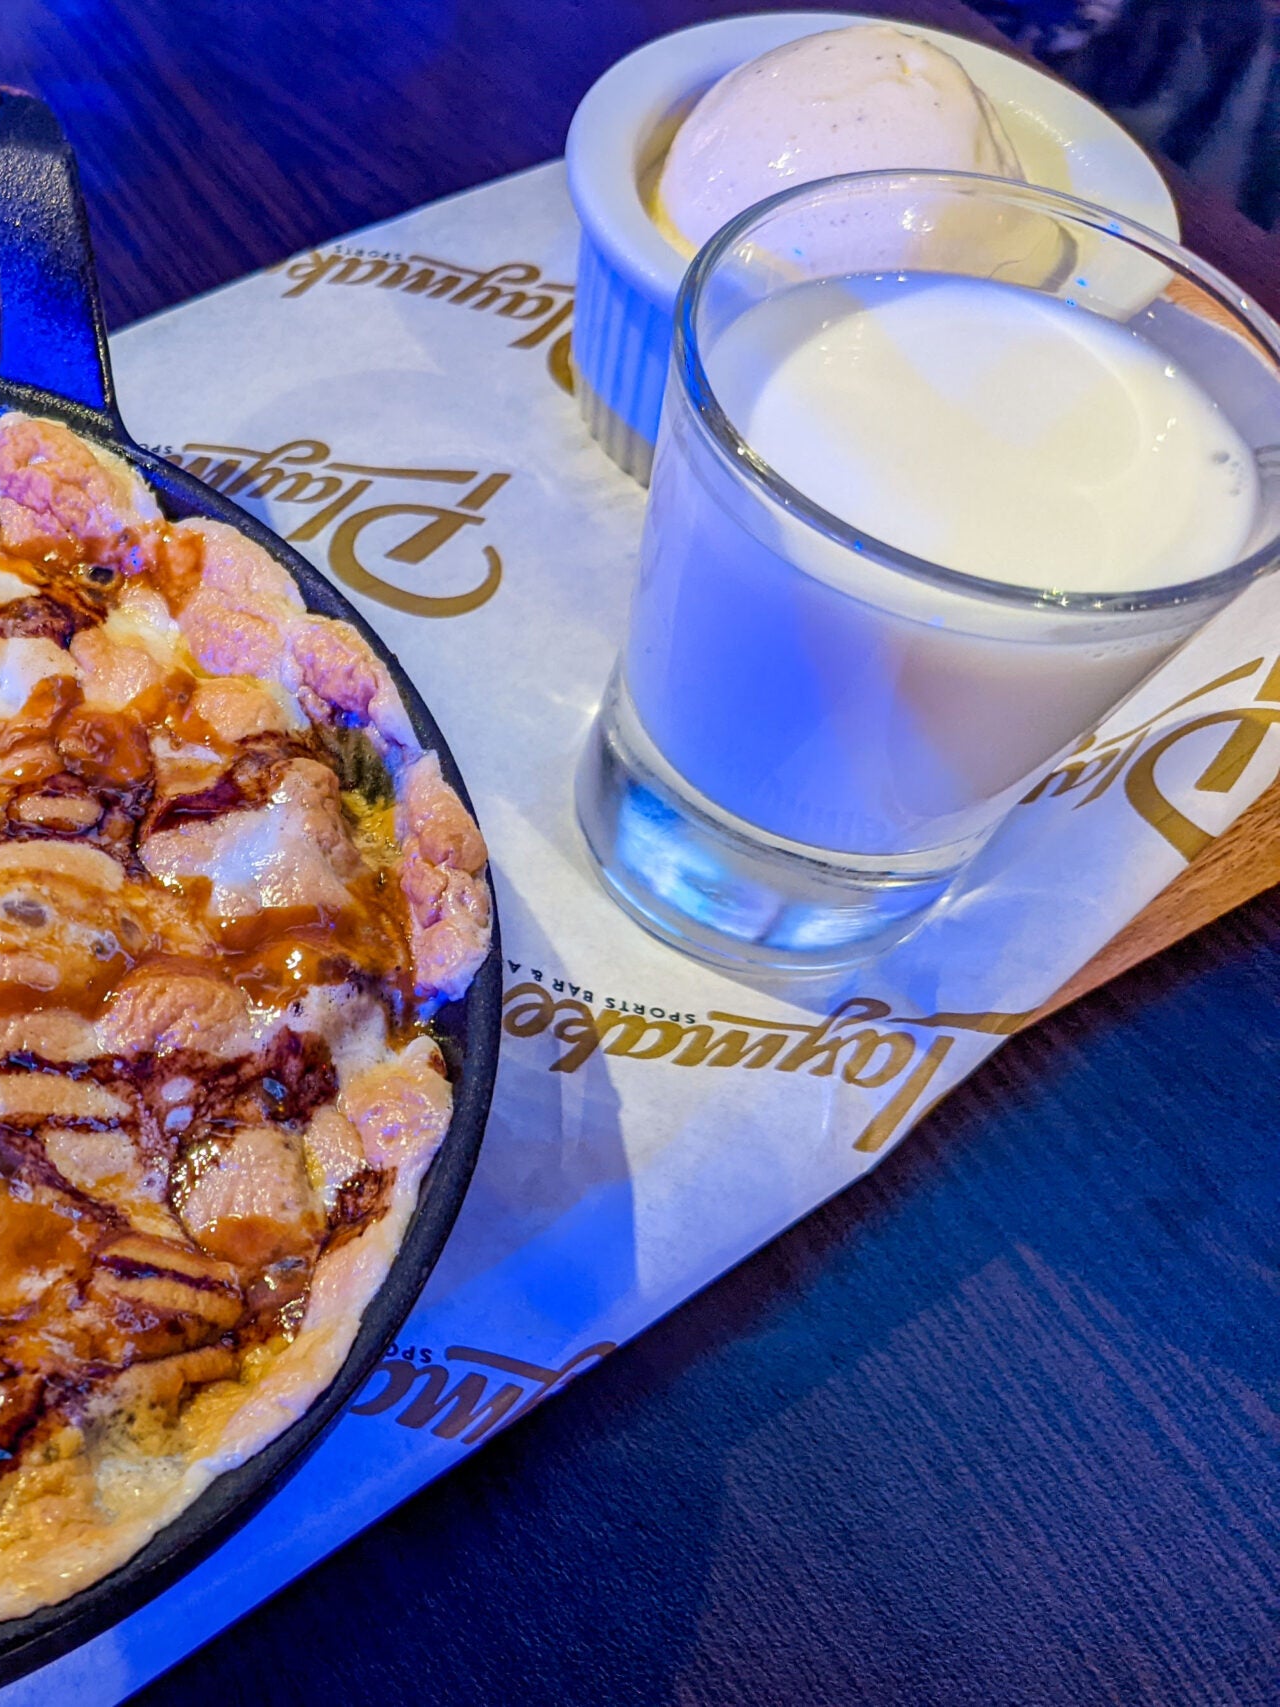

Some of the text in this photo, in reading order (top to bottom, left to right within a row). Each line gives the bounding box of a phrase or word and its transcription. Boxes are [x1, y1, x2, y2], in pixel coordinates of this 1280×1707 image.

[530, 968, 544, 984] &
[552, 978, 594, 1004] BAR
[605, 997, 696, 1024] SPORTS
[502, 982, 1029, 1152] laymake
